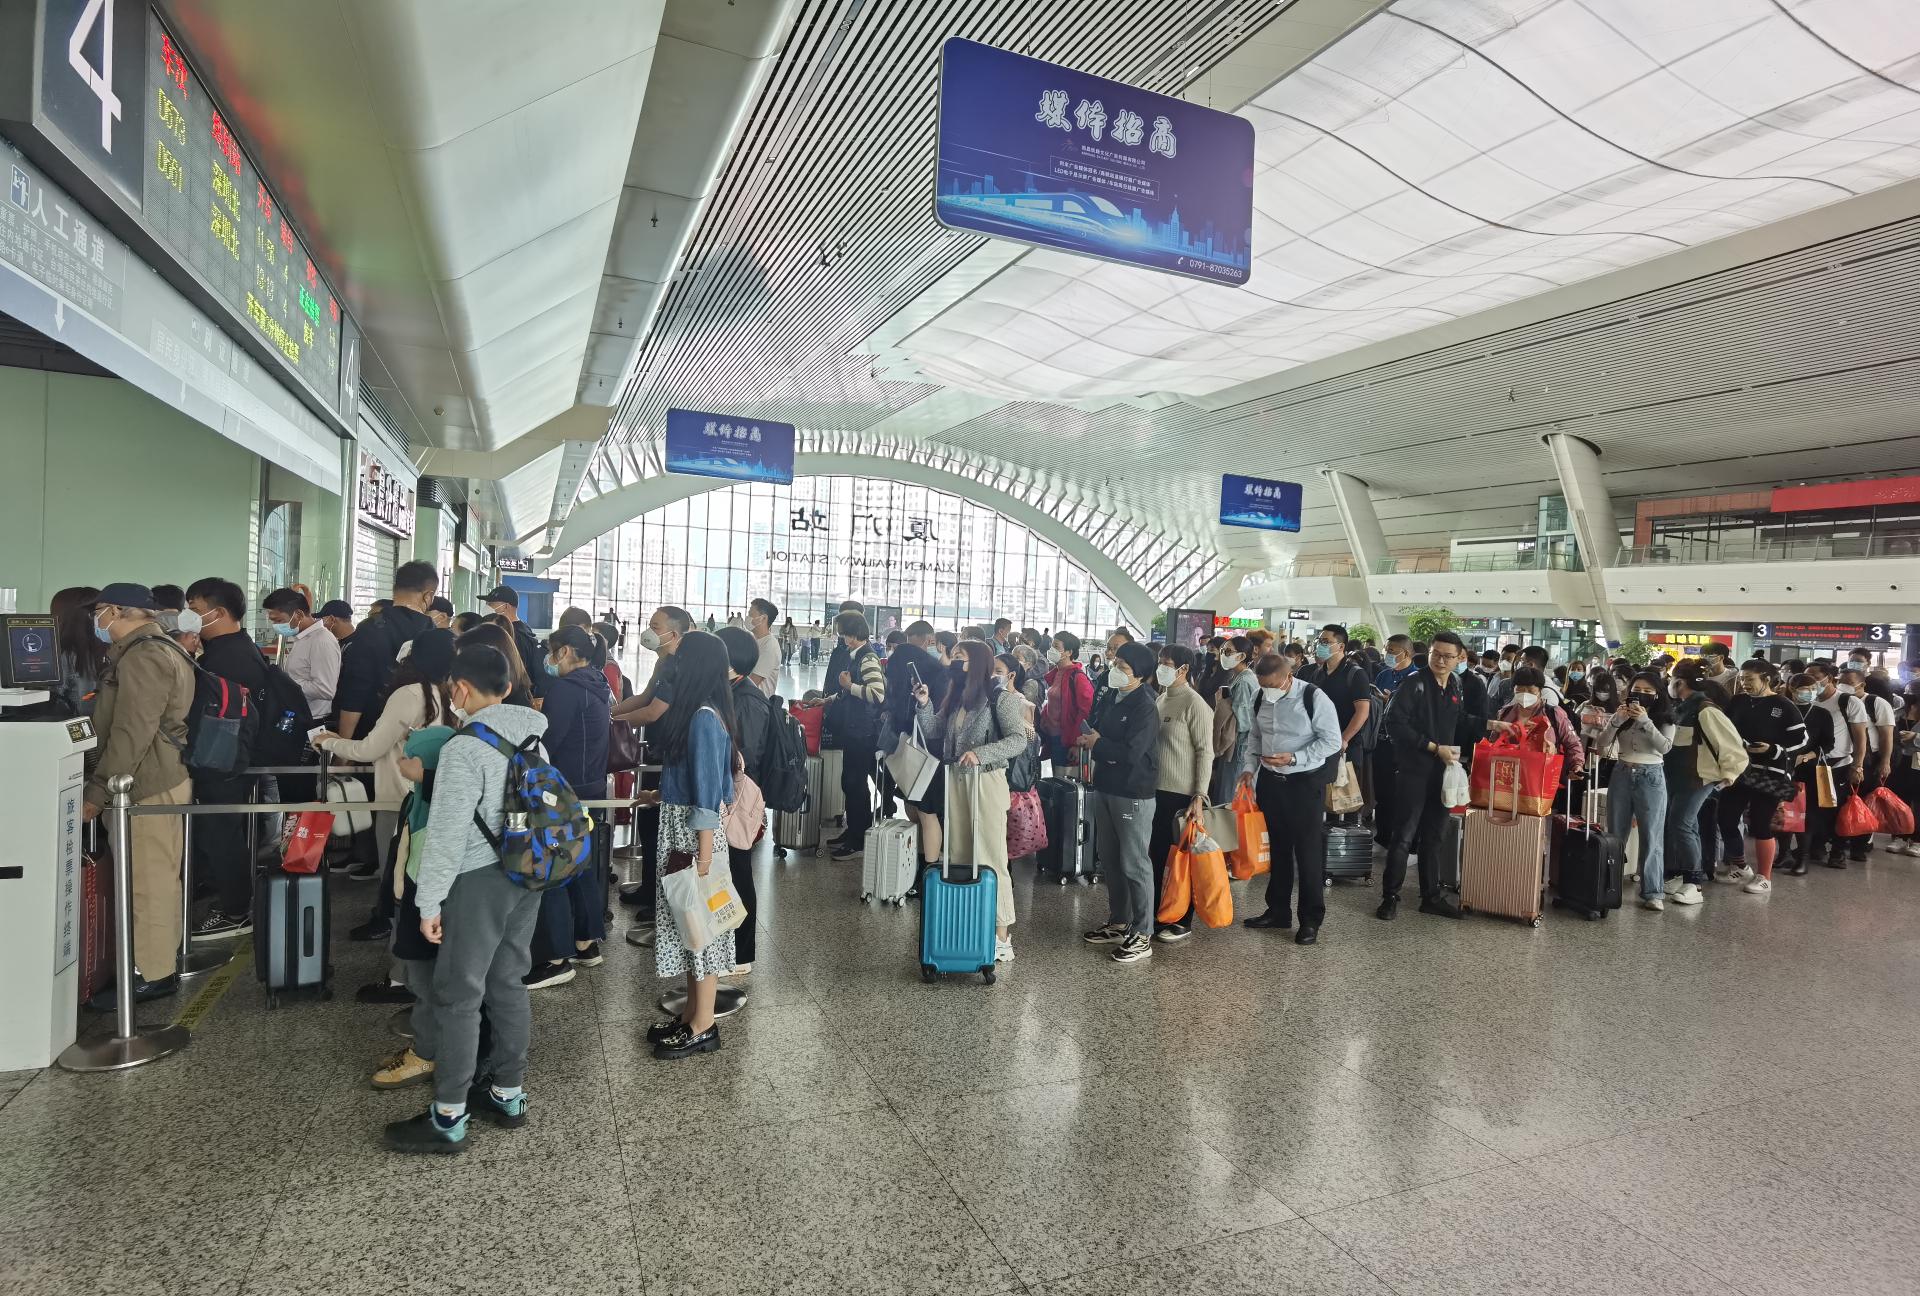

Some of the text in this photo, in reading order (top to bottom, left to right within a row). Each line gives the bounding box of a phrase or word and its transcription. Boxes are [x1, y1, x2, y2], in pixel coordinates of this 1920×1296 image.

[69, 0, 121, 154] 4
[1035, 89, 1177, 159] 媒体招商
[31, 187, 105, 271] 人工通道
[1189, 259, 1243, 279] 0791-87035263
[1756, 624, 1767, 638] 3
[1870, 626, 1883, 641] 3
